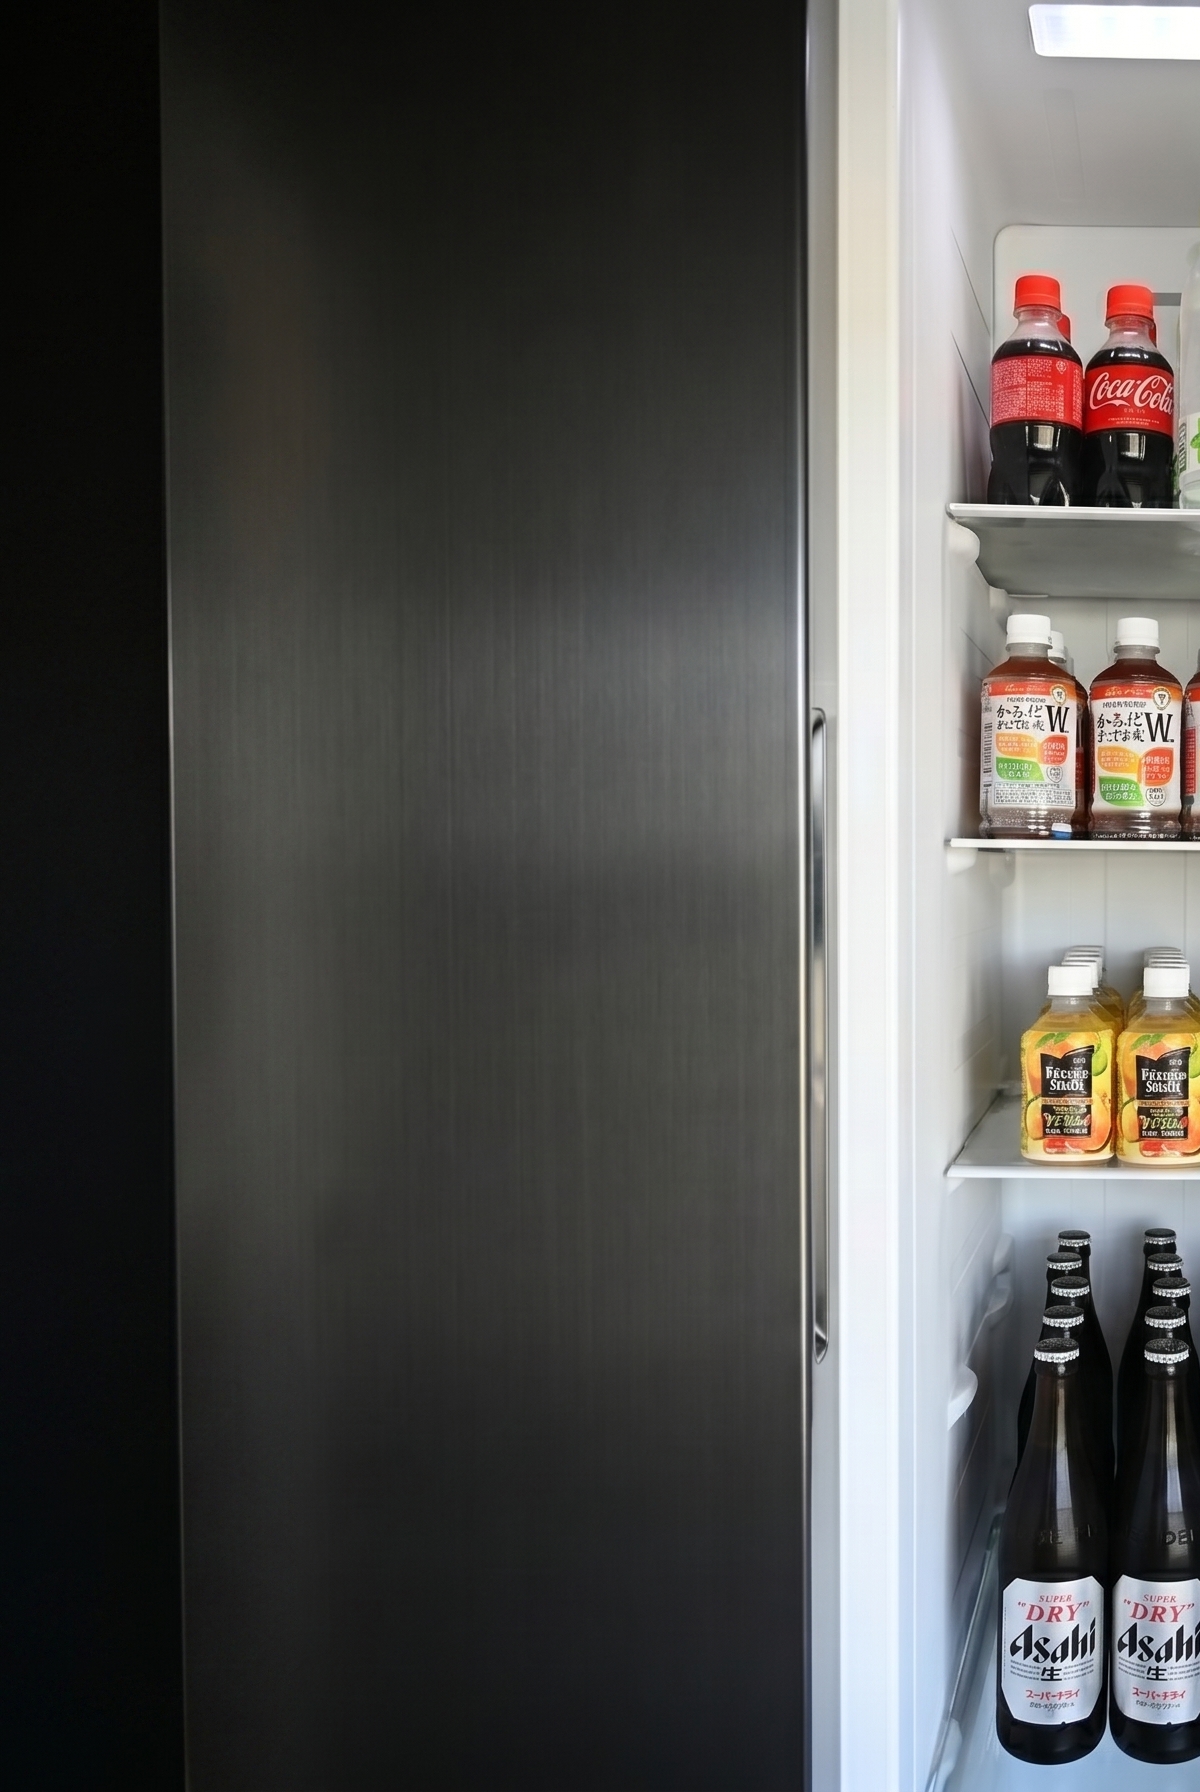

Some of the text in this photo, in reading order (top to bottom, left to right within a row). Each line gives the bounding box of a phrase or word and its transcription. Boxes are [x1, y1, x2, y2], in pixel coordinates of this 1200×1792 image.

[1039, 1594, 1072, 1603] SUPER
[1143, 1593, 1177, 1604] SUPER
[1009, 1617, 1097, 1664] Asahi
[1040, 1666, 1063, 1681] 生
[1146, 1665, 1168, 1681] 生
